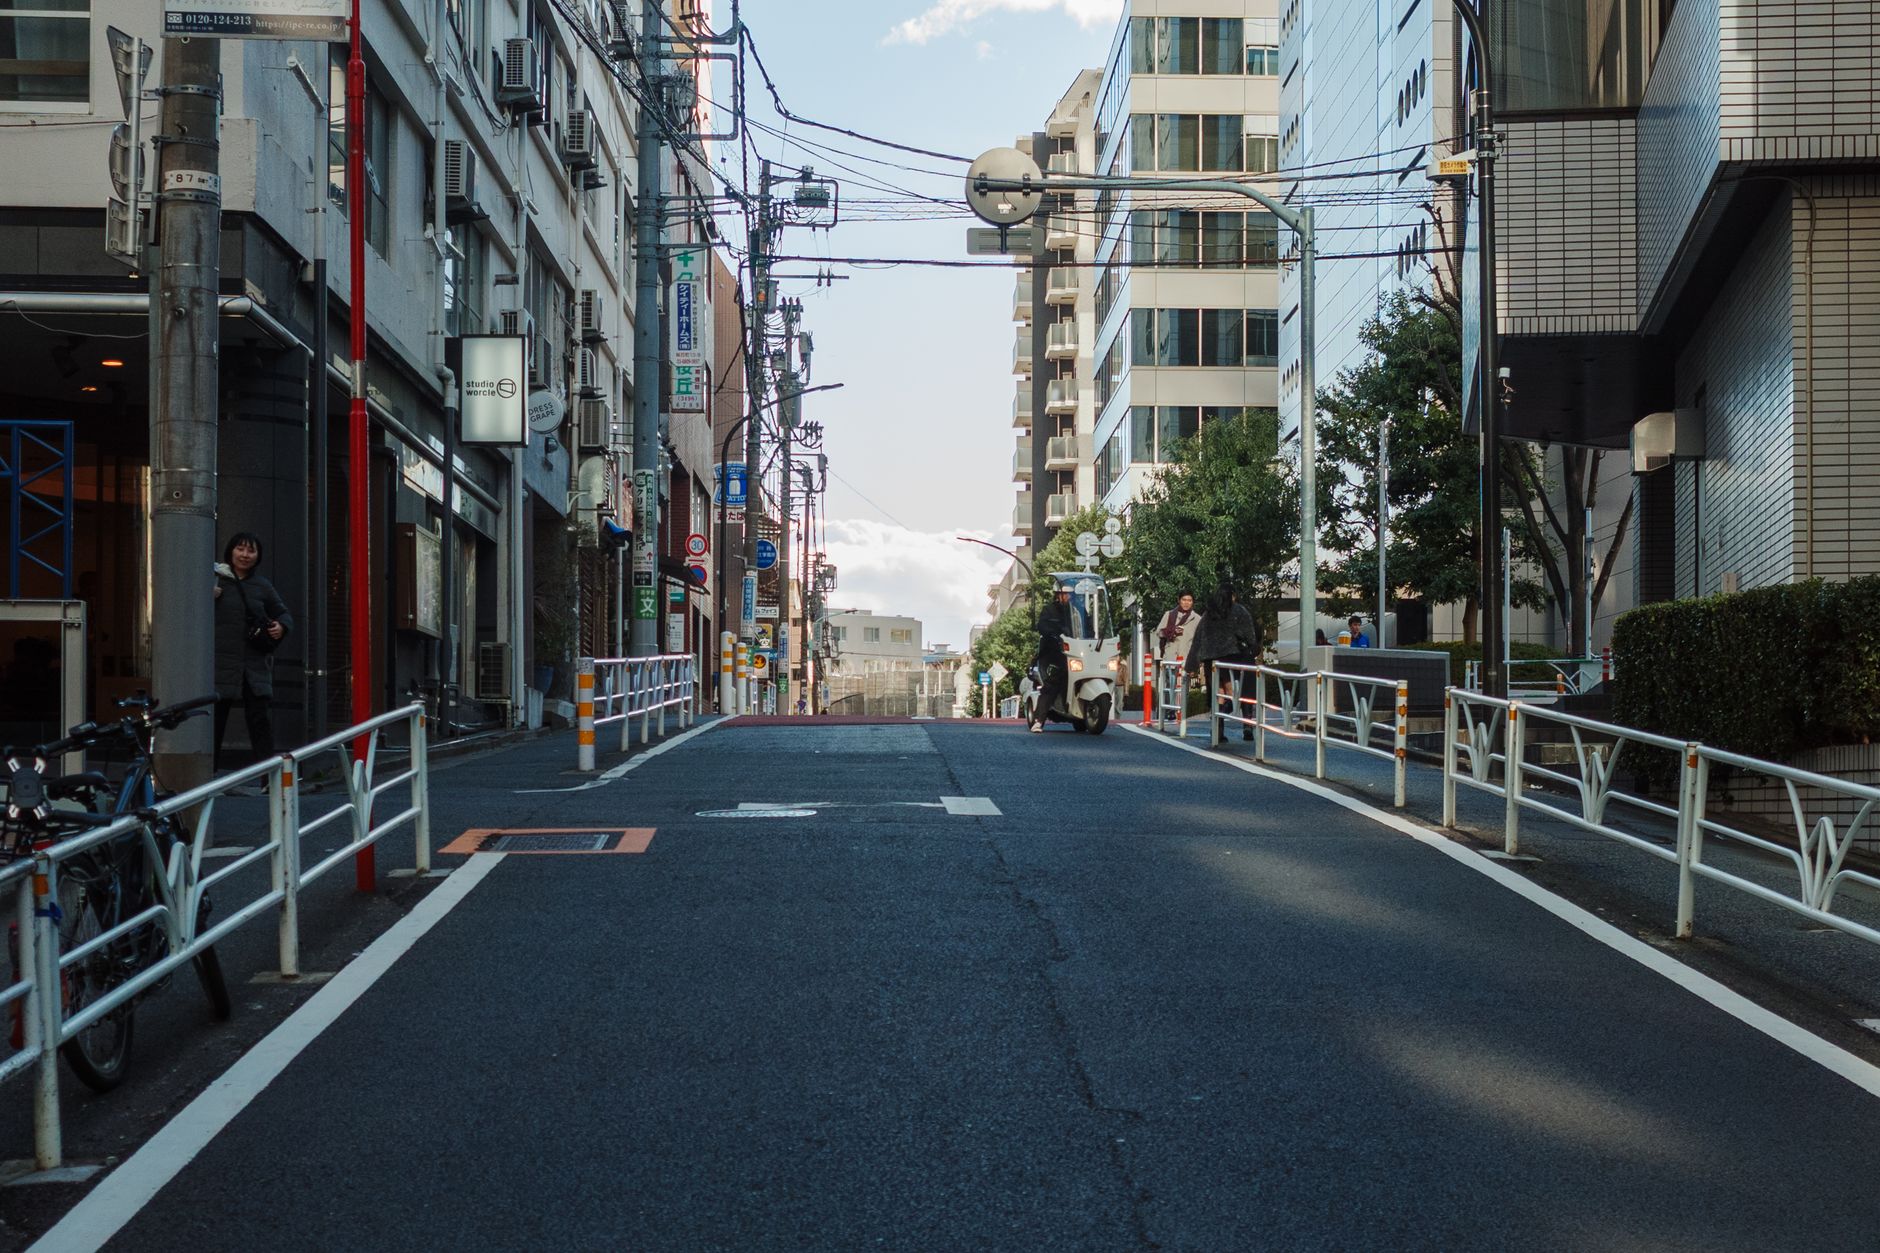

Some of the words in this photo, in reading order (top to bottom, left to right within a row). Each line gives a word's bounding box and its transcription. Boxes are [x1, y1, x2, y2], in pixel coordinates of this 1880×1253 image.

[185, 14, 252, 25] 0120-124-213
[466, 380, 495, 389] studio
[466, 389, 497, 397] worcle
[528, 402, 554, 416] DRESS
[530, 409, 556, 423] GRAPE
[691, 540, 704, 551] 30
[640, 596, 656, 614] 文
